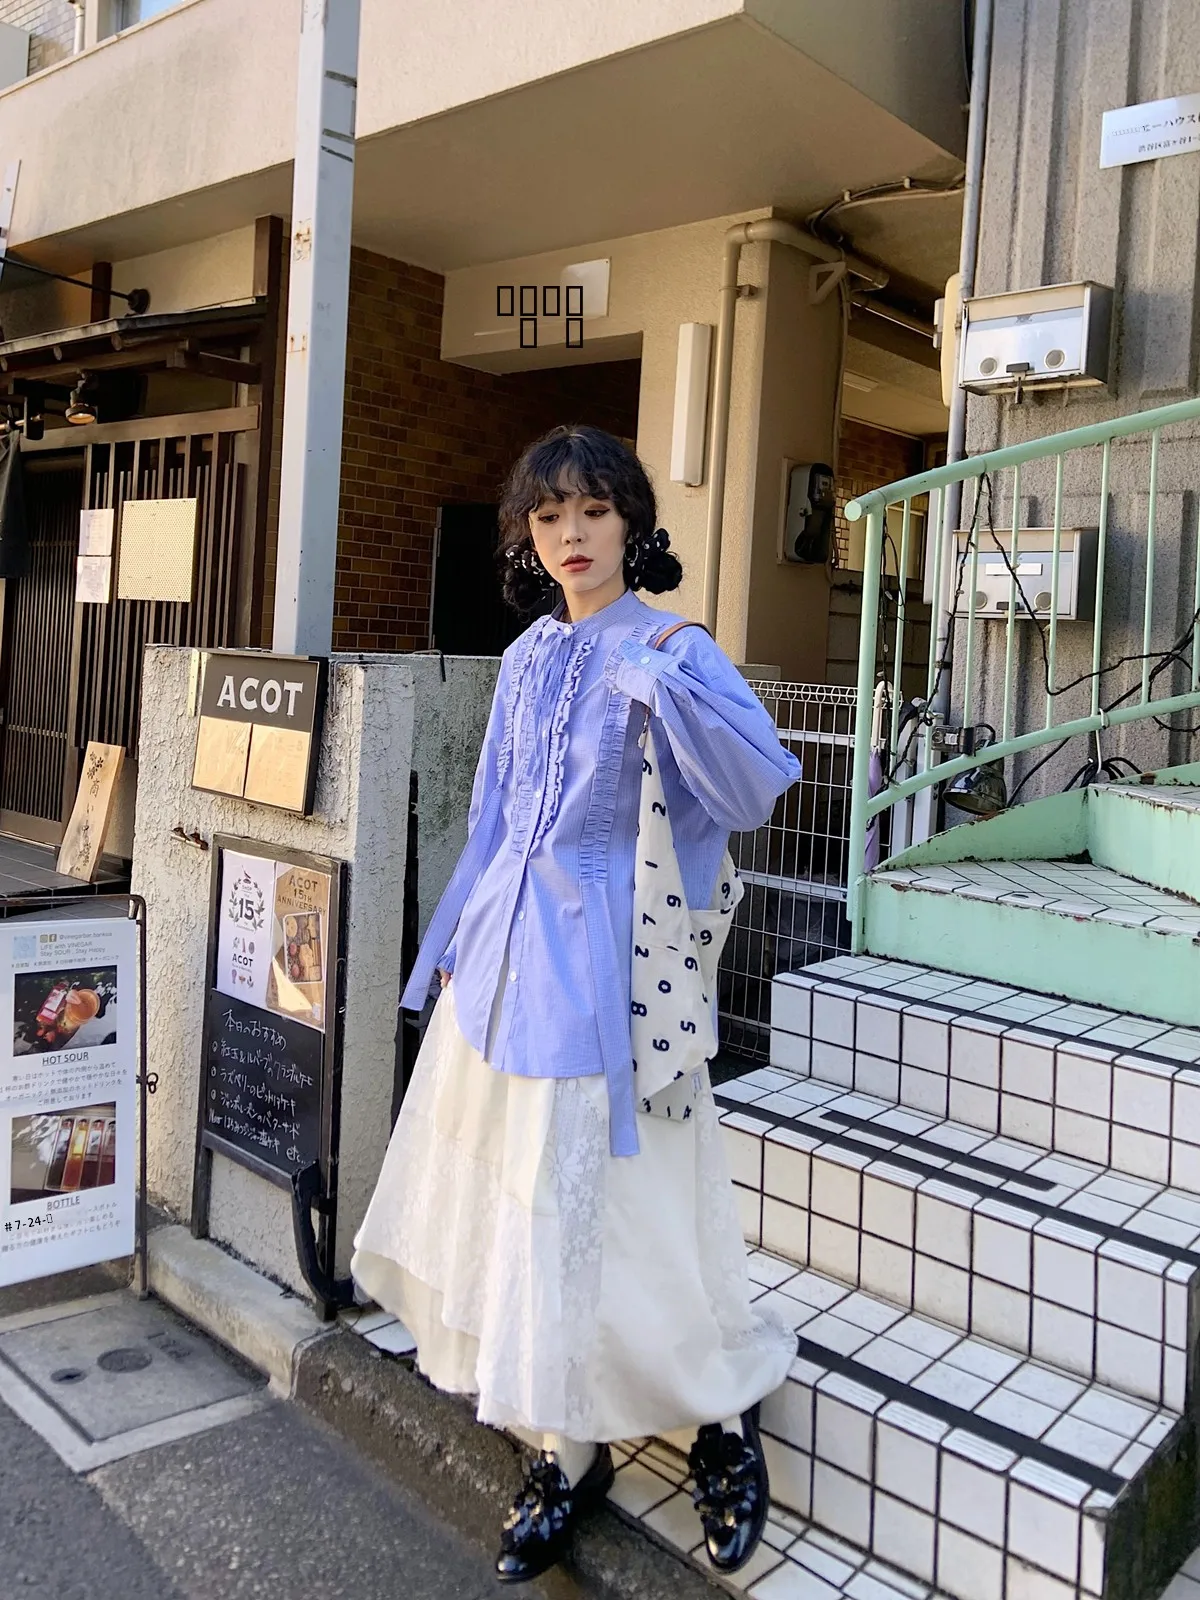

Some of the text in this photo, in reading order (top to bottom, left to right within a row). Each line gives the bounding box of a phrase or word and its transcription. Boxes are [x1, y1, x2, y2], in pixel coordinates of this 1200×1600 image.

[216, 675, 304, 716] ACOT
[289, 875, 318, 892] ACOT
[239, 898, 254, 920] 15
[231, 953, 253, 967] ACOT
[222, 1008, 287, 1050] 本日のおすすめ
[42, 1051, 89, 1066] HOT SOUR
[47, 1195, 80, 1211] BOTTLE
